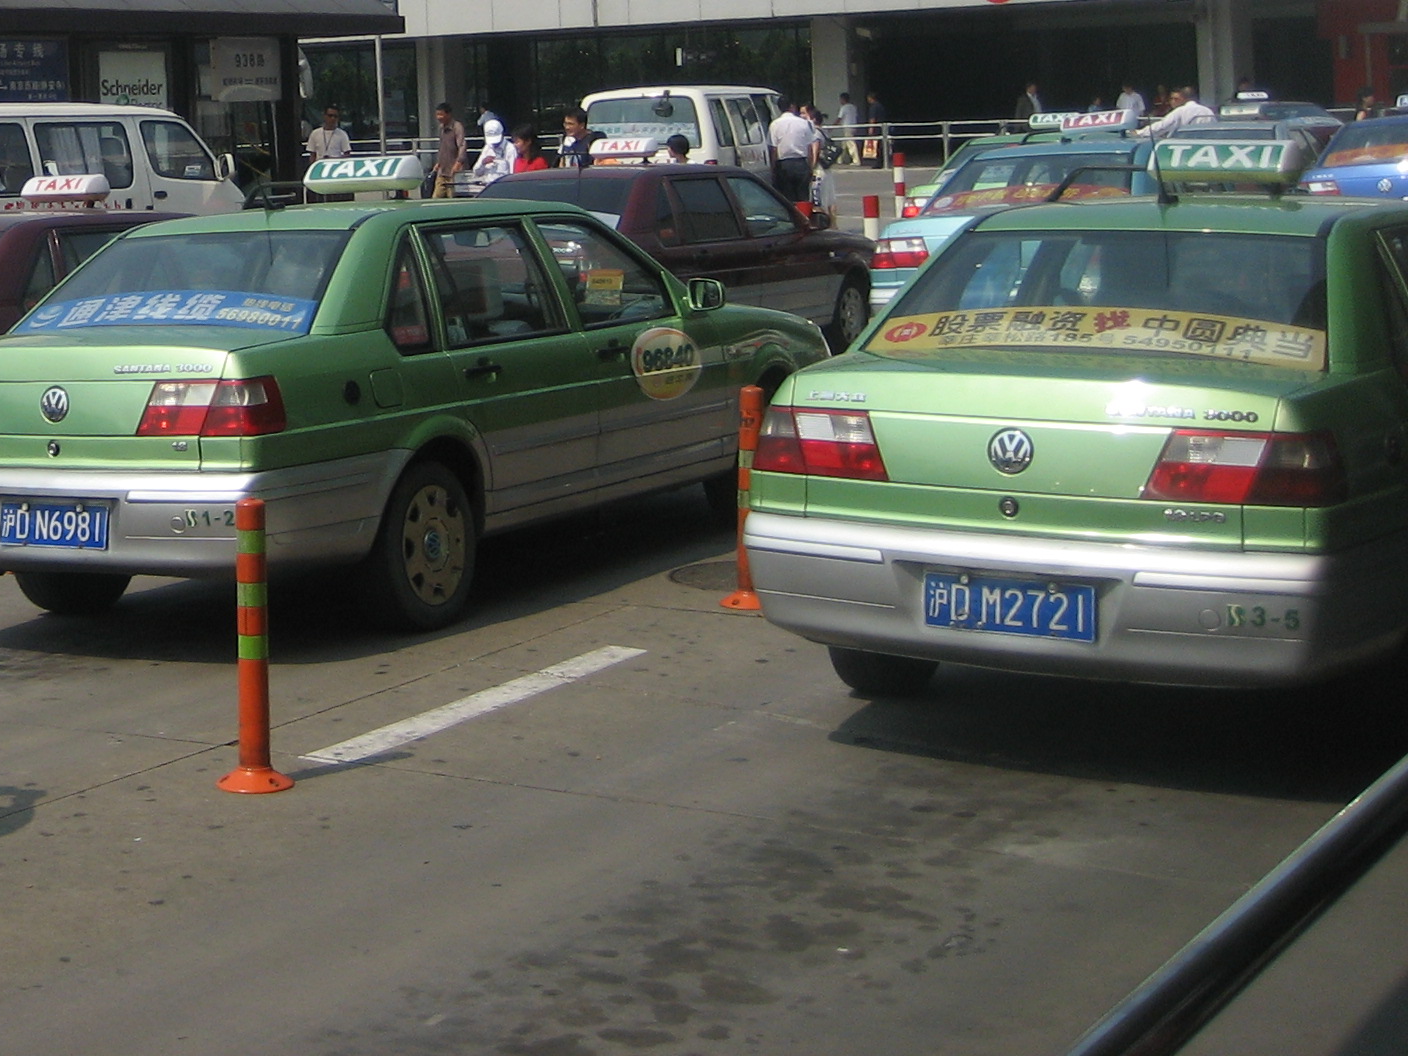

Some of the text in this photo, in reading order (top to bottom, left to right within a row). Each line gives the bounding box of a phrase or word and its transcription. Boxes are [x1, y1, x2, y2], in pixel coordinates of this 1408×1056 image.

[101, 79, 163, 96] Schneider
[1067, 110, 1125, 126] TAXI
[600, 141, 640, 151] TAXI
[1168, 145, 1272, 169] TAXI
[316, 157, 395, 178] TAXI
[35, 177, 83, 192] TAXI
[113, 363, 213, 374] SANTANA 3000
[1203, 408, 1259, 423] 3000
